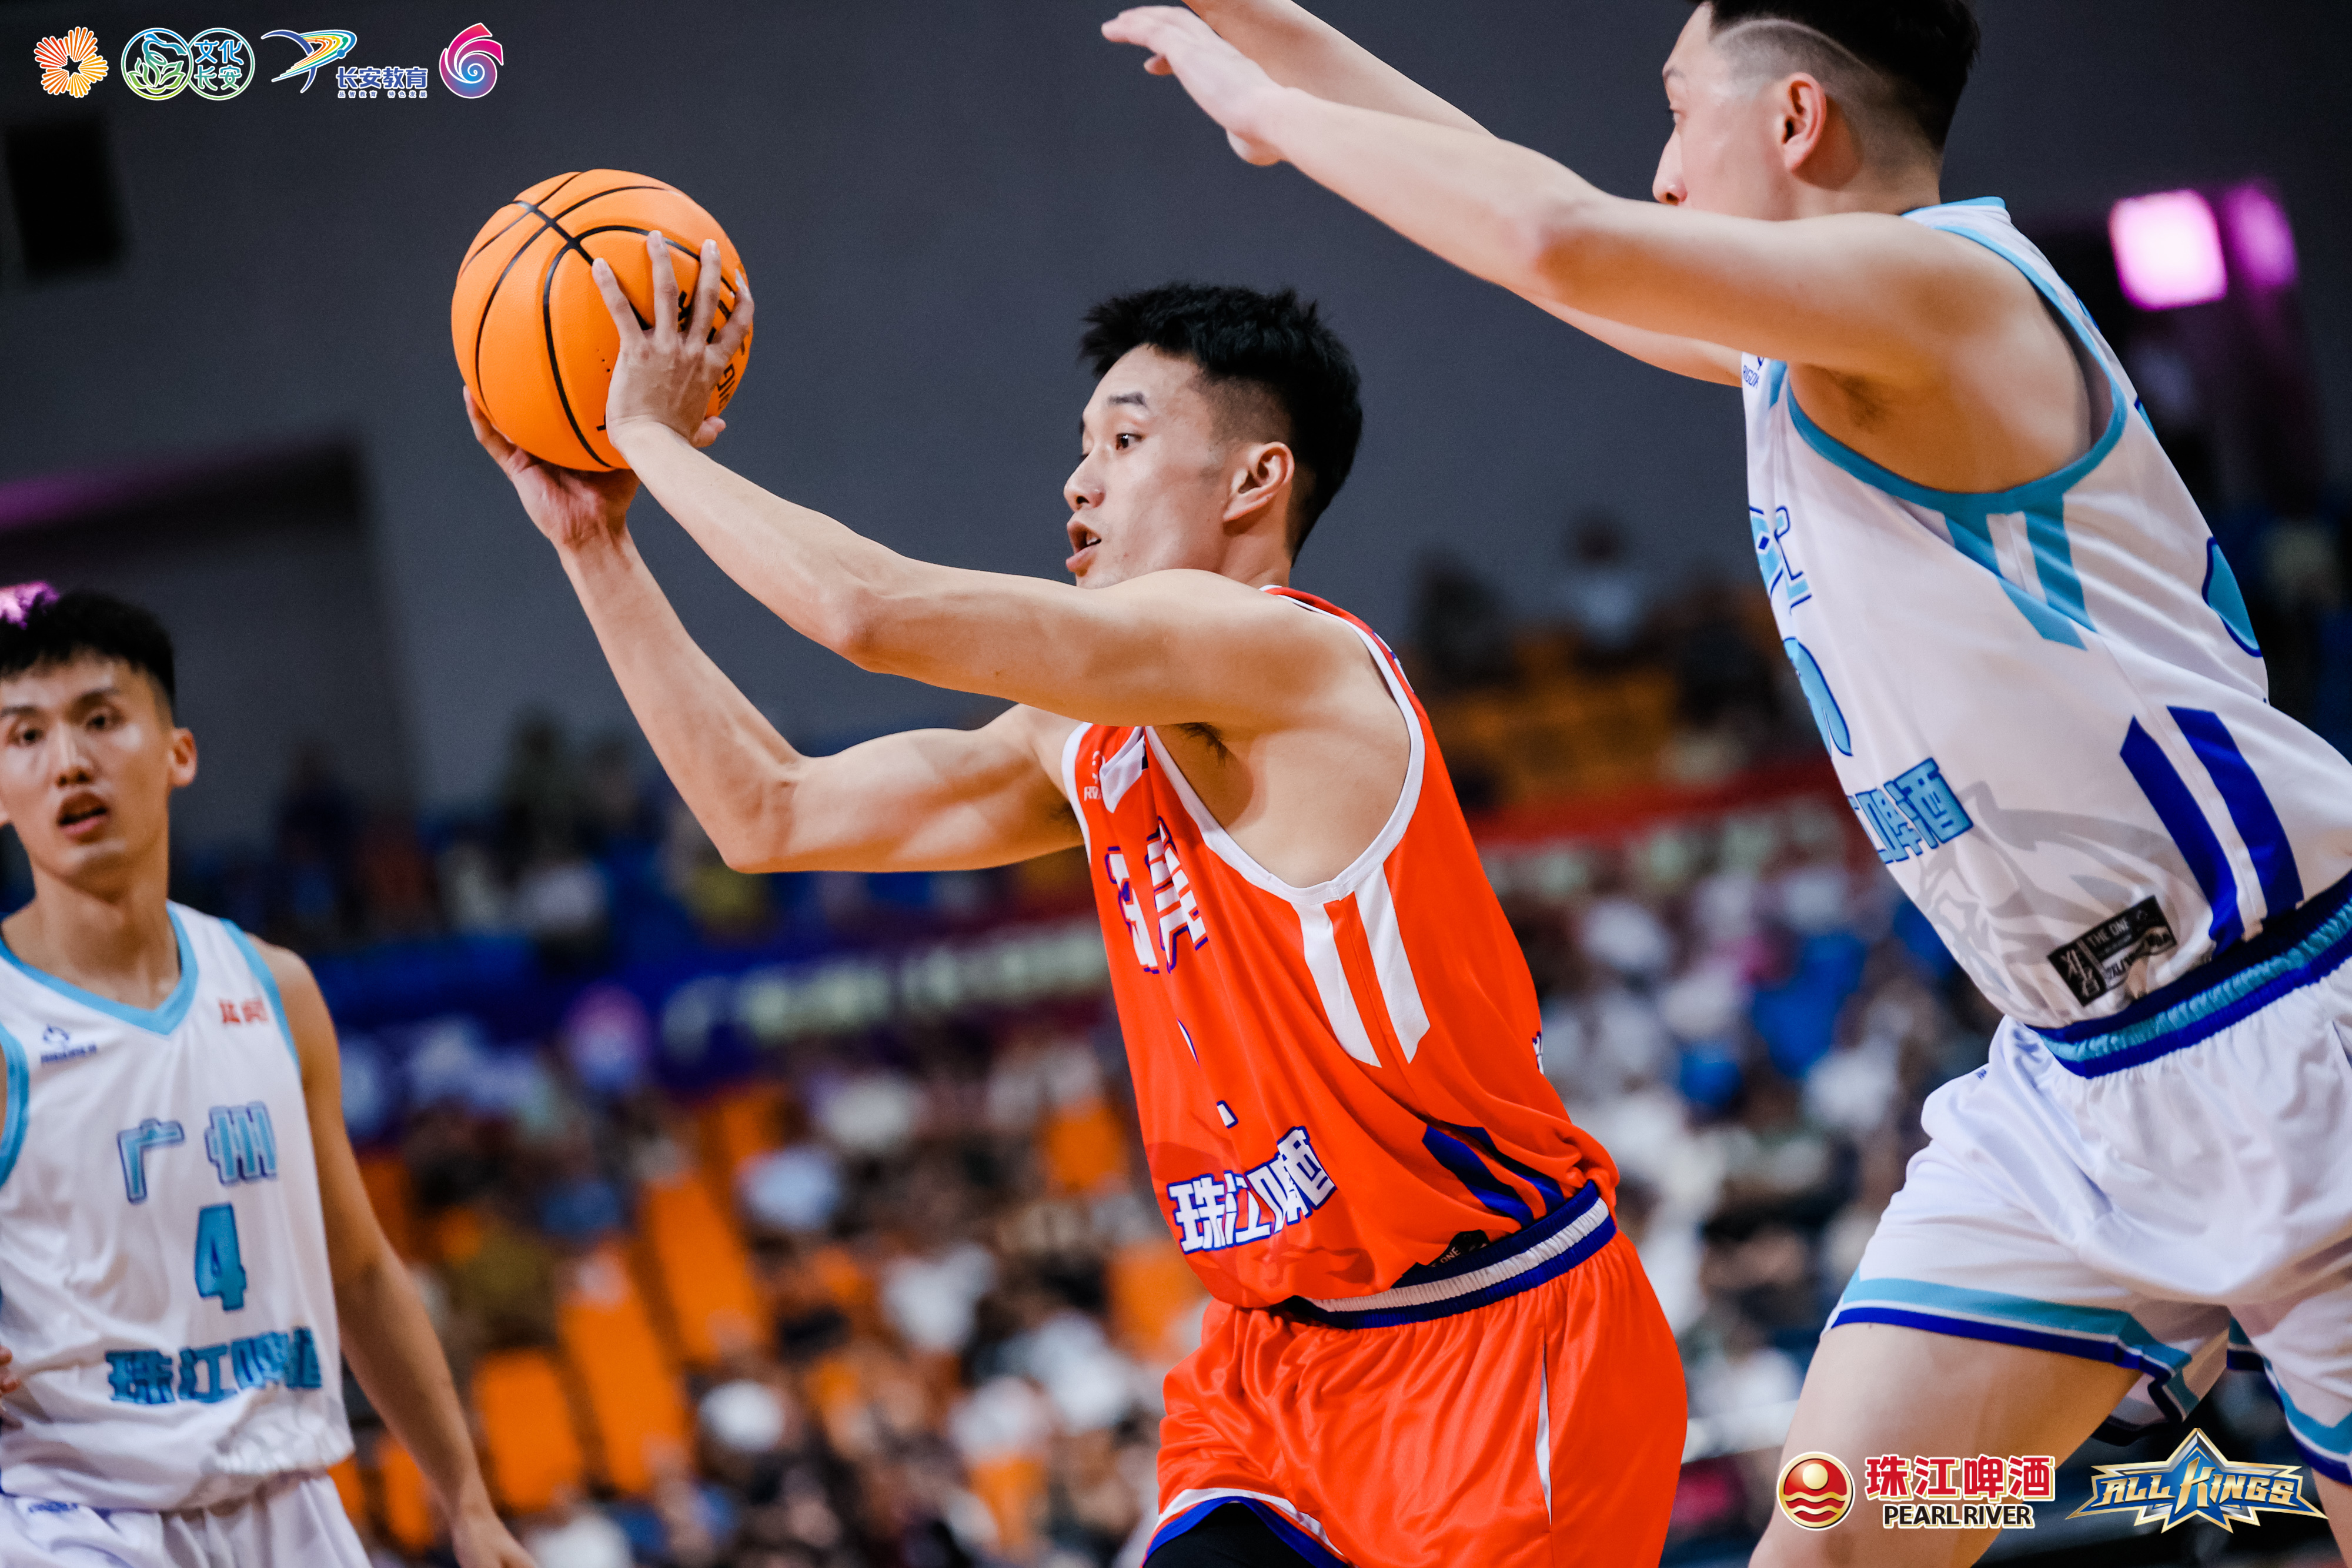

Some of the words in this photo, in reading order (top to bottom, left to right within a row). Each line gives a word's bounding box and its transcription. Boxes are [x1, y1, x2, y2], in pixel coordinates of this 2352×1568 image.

[1847, 757, 1974, 865] 啤酒
[117, 1101, 278, 1205] 广州
[194, 1201, 248, 1312] 4
[1440, 1246, 1461, 1263] ONE
